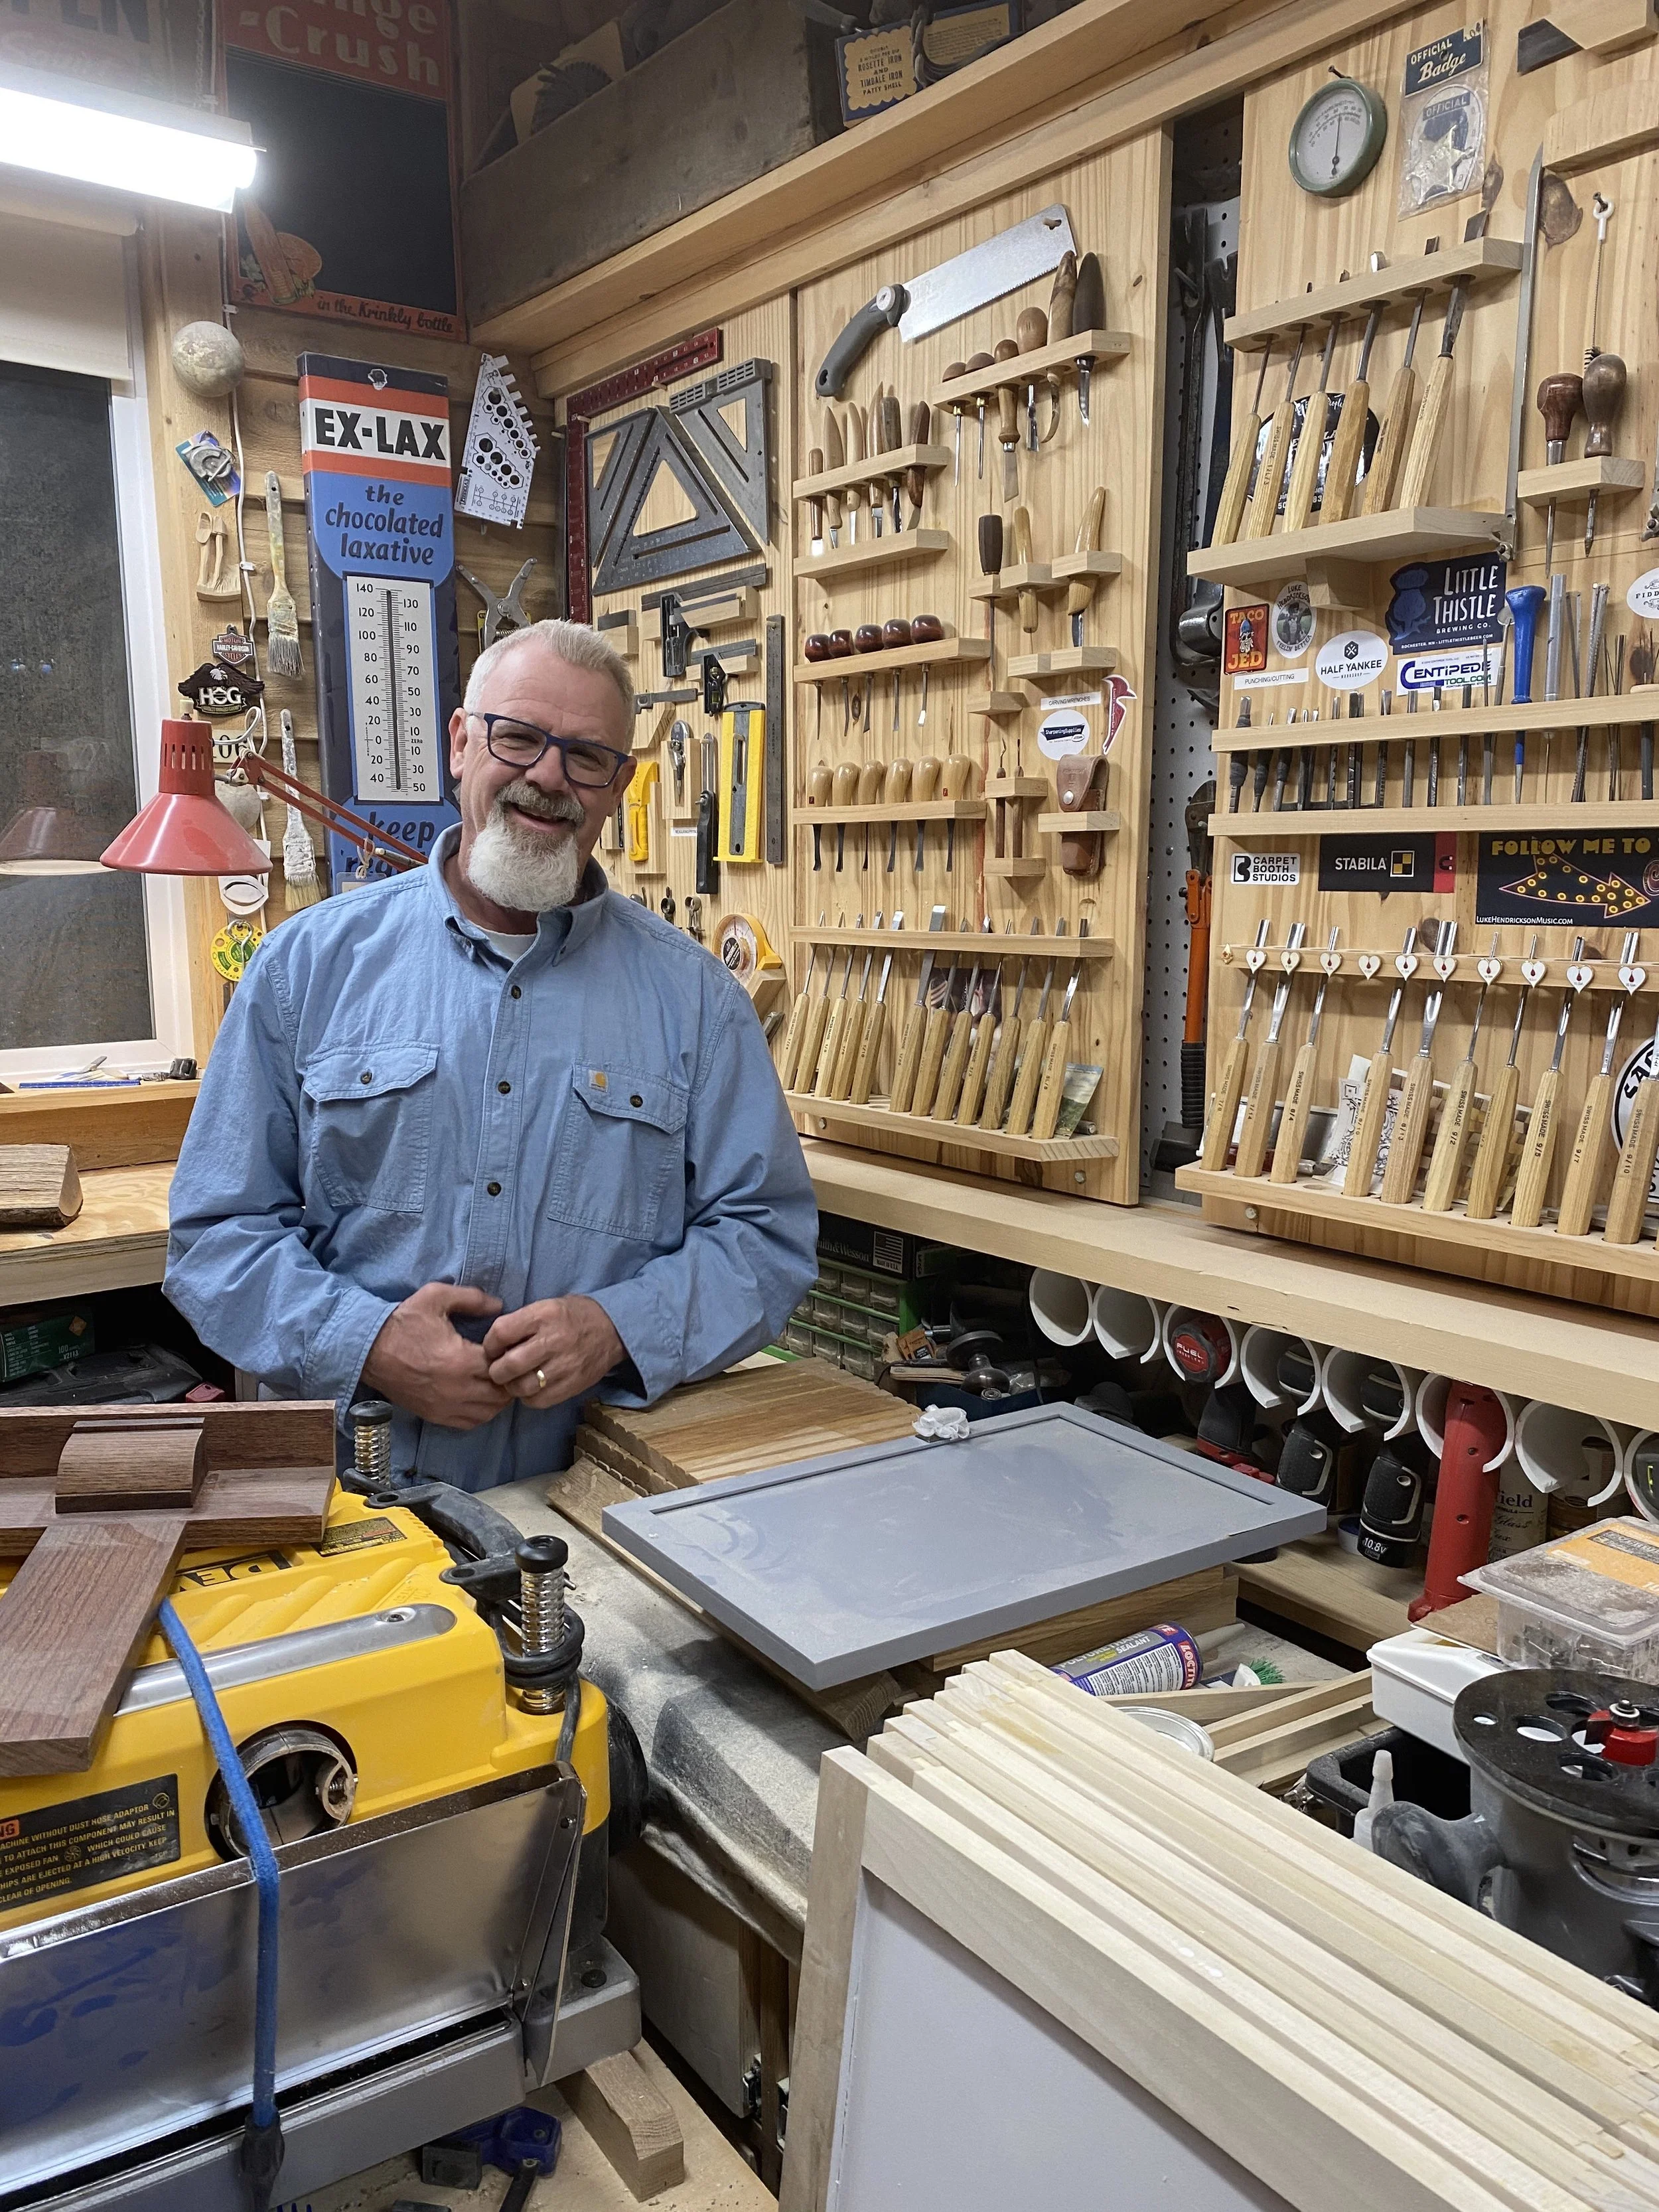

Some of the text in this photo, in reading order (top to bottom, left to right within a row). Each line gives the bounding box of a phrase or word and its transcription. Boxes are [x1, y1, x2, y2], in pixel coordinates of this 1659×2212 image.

[240, 5, 439, 86] -Crush
[1411, 38, 1452, 64] OFFICIAL
[858, 54, 902, 72] ROSETTE IRON
[1417, 52, 1466, 84] Badge
[860, 70, 902, 88] TIMBALE IRON
[863, 82, 902, 96] PATTY SHELL
[1426, 96, 1467, 117] OFFICIAL
[317, 297, 453, 333] in the Krinkly bottle
[315, 407, 445, 461] EX-LAX
[366, 484, 404, 505] the
[325, 502, 444, 538] chocolated
[341, 533, 434, 564] laxative
[356, 583, 373, 592] 140
[1287, 584, 1302, 593] LUKE
[1444, 565, 1498, 595] LITTLE
[403, 599, 419, 608] 130
[1433, 594, 1496, 625] THISTLE
[358, 608, 374, 617] 120
[1230, 609, 1264, 625] TACO
[404, 622, 417, 631] 110
[1436, 624, 1473, 634] BREWING
[358, 631, 376, 640] 100
[364, 653, 377, 662] 80
[406, 644, 419, 654] 90
[1228, 650, 1262, 670] JED
[1321, 660, 1382, 675] HALF YANKEE
[407, 666, 419, 675] 70
[1244, 674, 1295, 684] PUNCHING/CUTTING
[365, 675, 378, 684] 60
[365, 696, 379, 705] 40
[408, 688, 420, 696] 50
[409, 707, 421, 716] 30
[368, 716, 380, 725] 20
[409, 727, 419, 735] 10
[371, 755, 383, 764] 20
[411, 747, 421, 755] 10
[370, 774, 384, 782] 40
[413, 765, 424, 774] 30
[413, 782, 425, 792] 50
[368, 811, 435, 848] keep
[1492, 837, 1651, 855] FOLLOW ME TO
[1254, 856, 1297, 865] CARPET
[1335, 857, 1386, 871] STABILA
[1407, 1082, 1415, 1100] SWISS
[1459, 1090, 1467, 1108] SWISS
[1403, 1101, 1411, 1118] MADE
[1454, 1109, 1463, 1126] MADE
[1542, 1099, 1551, 1119] SWISS
[1538, 1119, 1548, 1138] MADE
[1573, 1105, 1592, 1163] SWISS MADE 9/7
[1623, 1109, 1643, 1174] SWISS MADE 9/10
[1177, 1343, 1203, 1359] FUEL
[1498, 1491, 1533, 1508] ield
[1116, 1635, 1151, 1654] SEALANT
[1, 1804, 149, 1850] ACHINE WITHOUT DUST HOSE ADAPTOR
[4, 1809, 175, 1863] TO ATTACH THIS COMPONENT MAY RESULT IN
[5, 1824, 167, 1876] EXPOSED FAN WHICH COULD CAUSE
[0, 1880, 19, 1889] HIPS
[21, 1874, 36, 1883] ARE
[38, 1865, 71, 1880] EJECTED
[73, 1861, 83, 1870] AT
[92, 1852, 110, 1864] HIGH
[113, 1844, 146, 1858] VELOCITY
[149, 1836, 167, 1848] KEEP
[24, 1887, 34, 1896] OF
[36, 1876, 72, 1893] OPENING.
